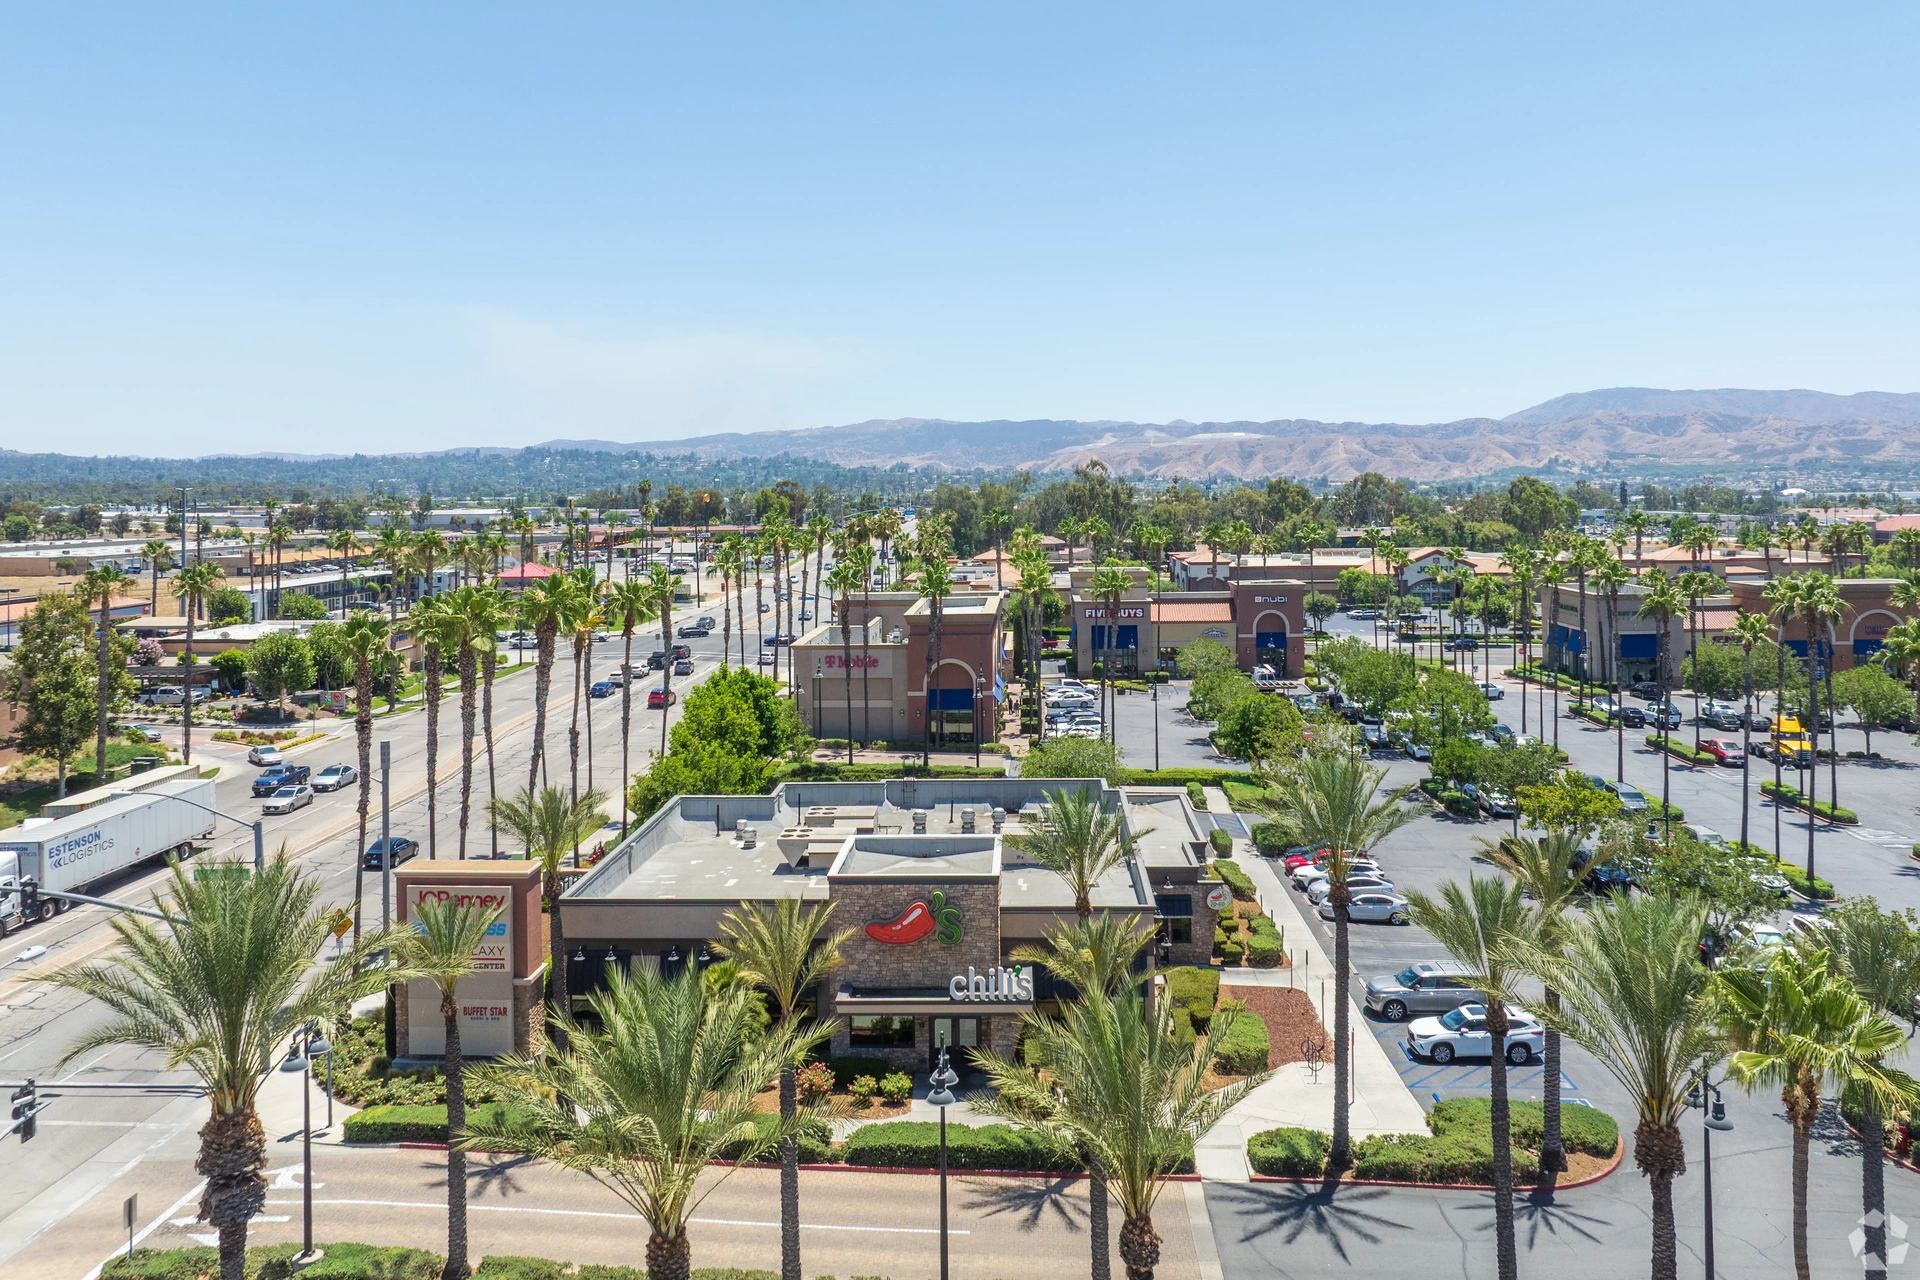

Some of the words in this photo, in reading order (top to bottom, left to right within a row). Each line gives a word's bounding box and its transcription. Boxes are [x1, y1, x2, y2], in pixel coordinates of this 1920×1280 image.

[837, 655, 879, 668] Moble
[48, 830, 101, 860] ESTENSON
[63, 838, 115, 867] LOGISTICS
[950, 965, 1032, 1001] chili's
[463, 1006, 488, 1017] BUFFET
[490, 1008, 508, 1017] STAR
